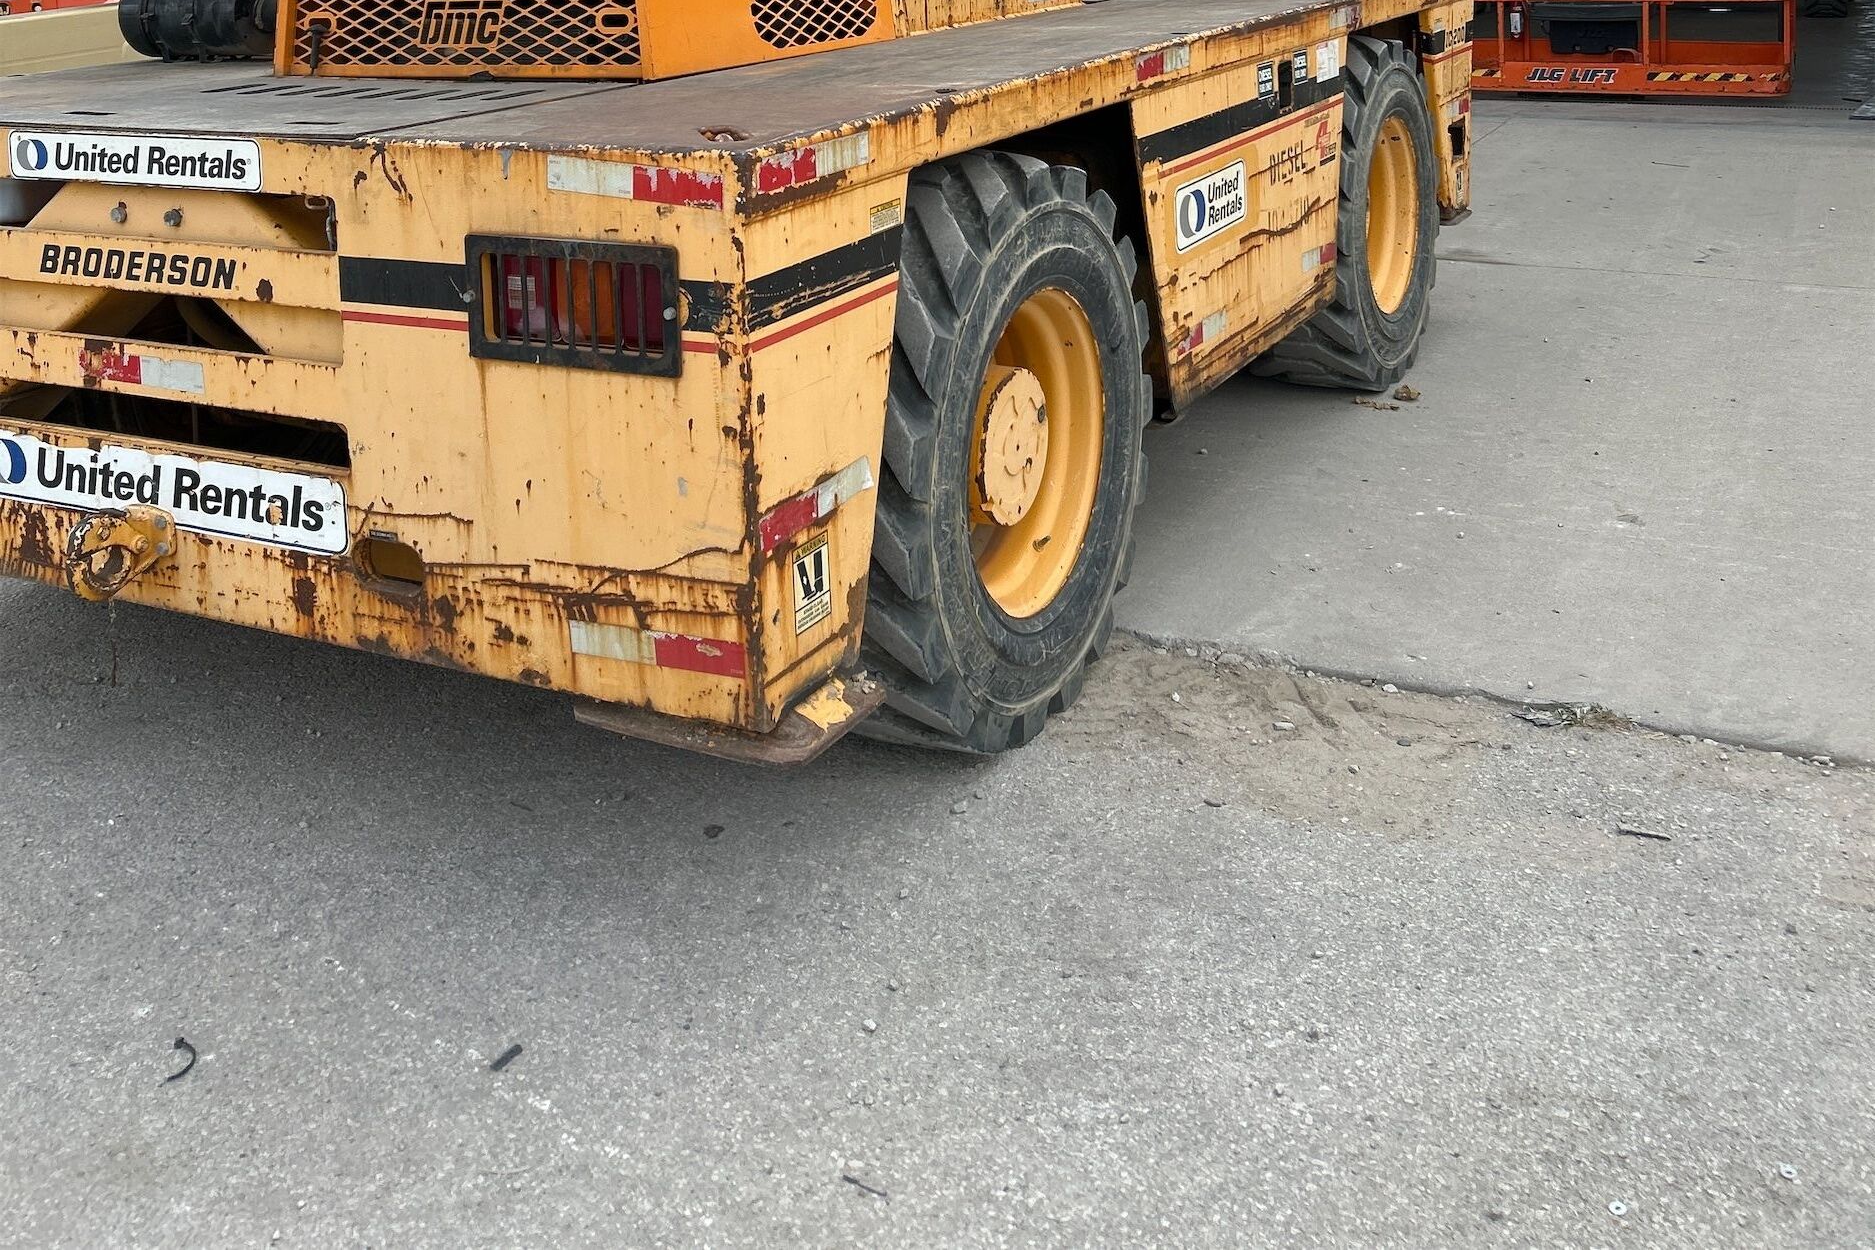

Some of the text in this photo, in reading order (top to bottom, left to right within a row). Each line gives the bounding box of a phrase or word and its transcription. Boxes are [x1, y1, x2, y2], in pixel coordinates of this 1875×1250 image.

[1526, 67, 1618, 83] JLG LIFT
[55, 141, 247, 180] United Rentals
[1208, 170, 1239, 203] United
[1208, 193, 1242, 226] Rentals
[40, 244, 236, 290] BRODERSON
[37, 447, 324, 532] United Rentals
